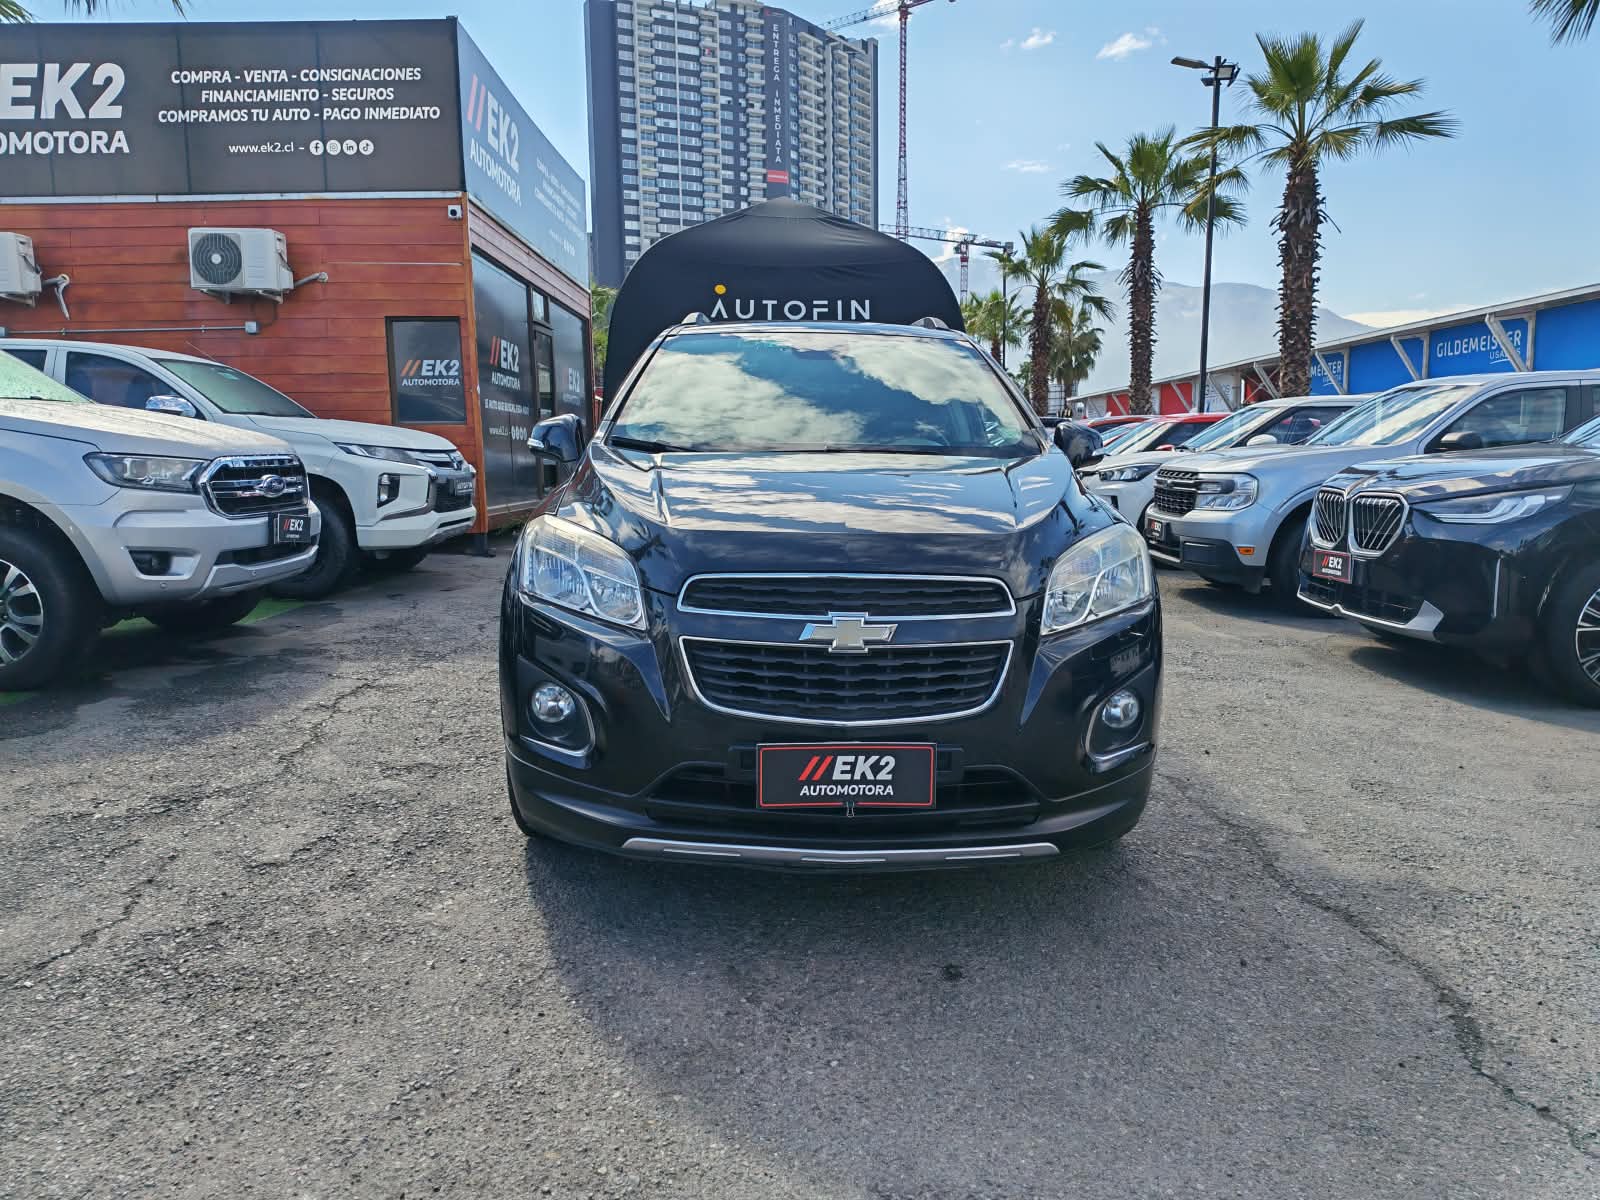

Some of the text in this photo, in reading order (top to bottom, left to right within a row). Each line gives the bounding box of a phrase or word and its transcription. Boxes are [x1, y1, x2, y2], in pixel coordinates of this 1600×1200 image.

[772, 24, 781, 81] ENTREGA
[171, 71, 232, 84] COMPRA
[244, 70, 288, 83] VENTA
[300, 68, 422, 82] CONSIGNACIONES
[0, 62, 125, 119] EK2
[201, 89, 319, 103] FINANCIAMIENTO
[331, 87, 394, 101] SEGUROS
[158, 109, 248, 122] COMPRAMOS
[251, 108, 268, 121] TU
[272, 108, 310, 121] AUTO
[323, 107, 361, 120] PAGO
[364, 106, 441, 120] INMEDIATO
[487, 90, 519, 175] EK2
[774, 90, 782, 163] INMEDIATA
[228, 142, 294, 153] www.ek2.cl
[470, 137, 522, 207] AUTOMOTORA
[710, 299, 871, 321] AUTOFIN
[500, 339, 520, 373] EK2
[421, 359, 460, 376] EK2
[401, 378, 460, 387] AUTOMOTORA
[491, 371, 521, 391] AUTOMOTORA
[832, 755, 896, 781] EK2
[800, 784, 894, 796] AUTOMOTORA
